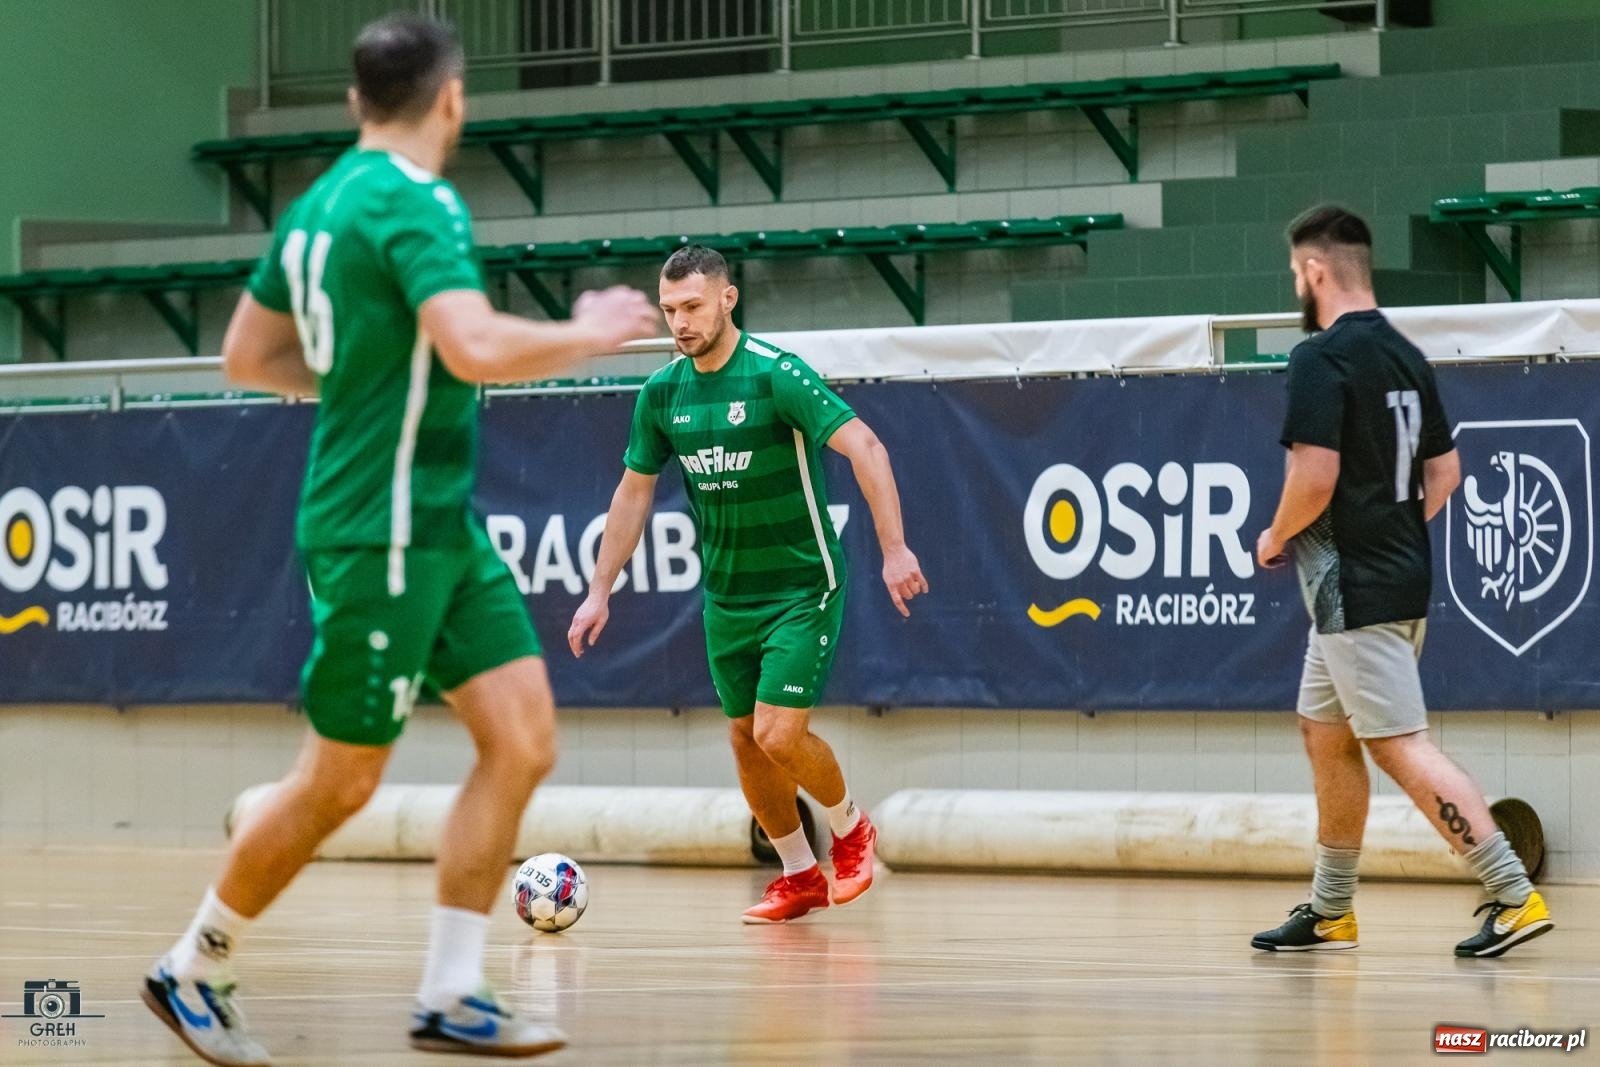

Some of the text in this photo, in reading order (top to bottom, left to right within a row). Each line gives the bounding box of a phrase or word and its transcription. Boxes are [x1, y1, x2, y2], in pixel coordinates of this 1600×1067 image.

[722, 480, 739, 489] PBG
[57, 592, 169, 632] RACIBÓRZ
[1115, 583, 1256, 626] RACIBÓRZ
[782, 684, 804, 694] JAKO
